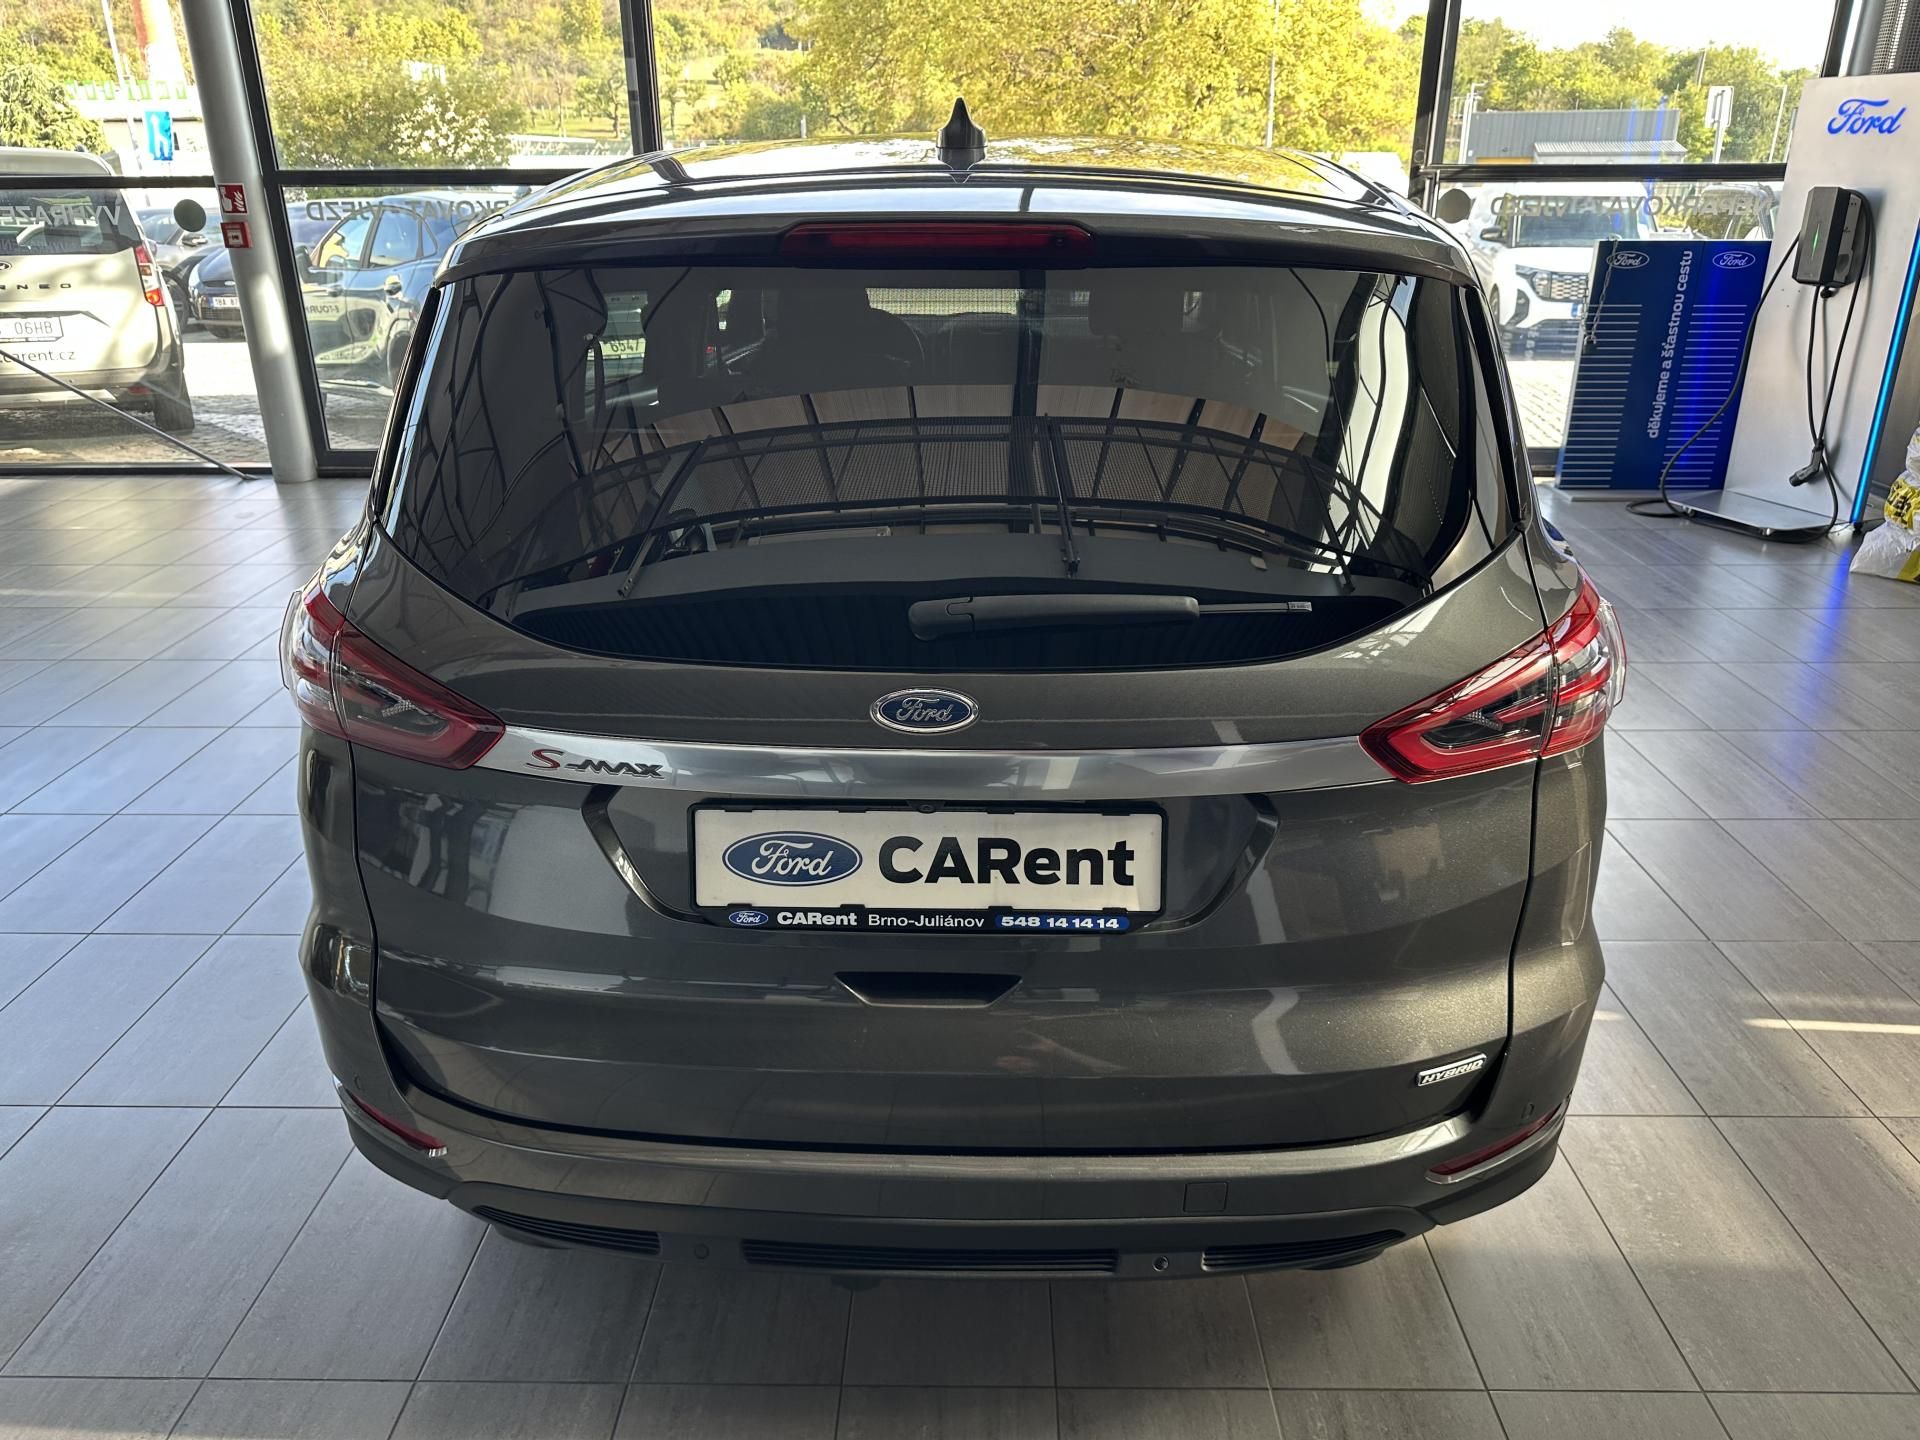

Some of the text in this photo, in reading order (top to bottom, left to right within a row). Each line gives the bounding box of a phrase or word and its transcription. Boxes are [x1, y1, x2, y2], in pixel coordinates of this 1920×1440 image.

[1827, 98, 1906, 134] Ford
[1614, 253, 1641, 266] Ford
[1719, 253, 1747, 266] Ford
[14, 320, 53, 335] 06HB
[1647, 250, 1693, 438] děkujeme a šťastnou cestu
[895, 697, 954, 722] Ford
[524, 748, 665, 780] S-MAX
[751, 835, 1135, 887] Ford CARent
[735, 911, 1120, 930] Ford CARent Brno-Juliánov 548 14 14 14
[1421, 1060, 1483, 1084] HYBRID
